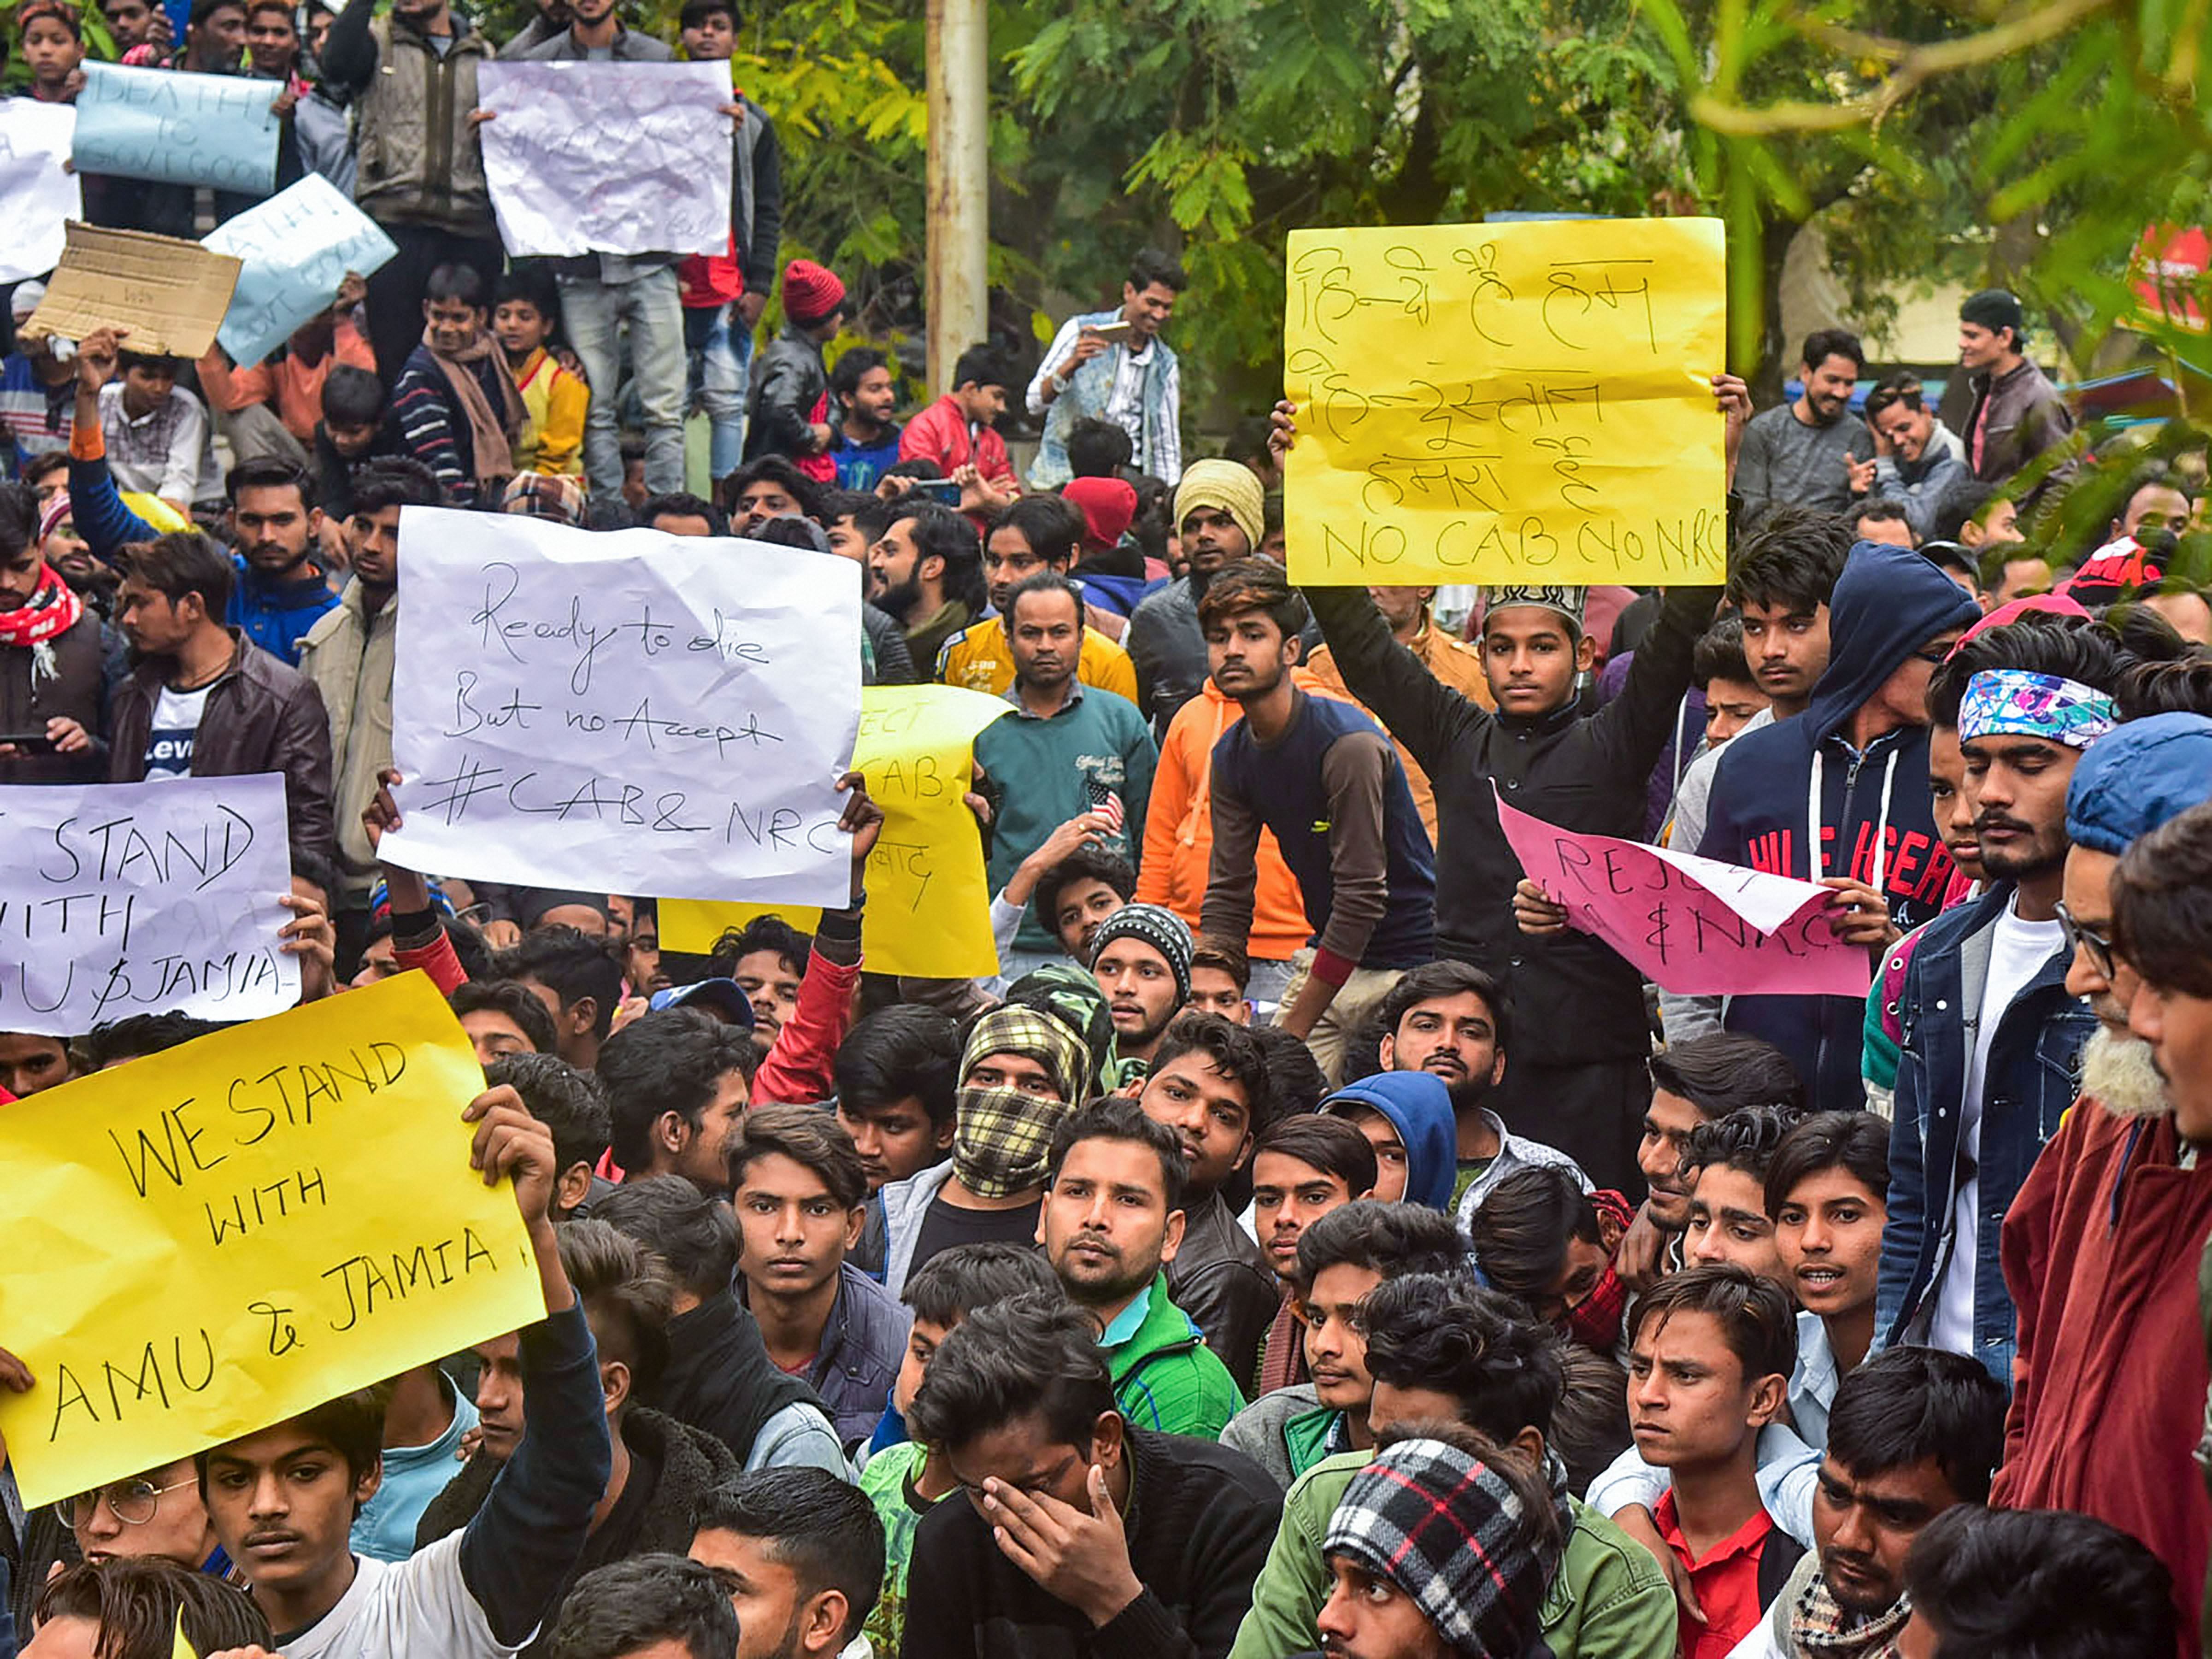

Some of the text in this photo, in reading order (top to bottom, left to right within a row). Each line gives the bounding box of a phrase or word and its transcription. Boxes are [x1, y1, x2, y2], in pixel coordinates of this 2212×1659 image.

[1542, 259, 1657, 354] हम
[1323, 520, 1406, 568] NO
[1435, 516, 1559, 566] CAB
[1656, 508, 1724, 572] NRC
[471, 562, 770, 695] Ready to die
[443, 670, 542, 737] But
[566, 706, 606, 733] no
[40, 804, 254, 891] STAND
[726, 801, 839, 854] NRC
[109, 1042, 406, 1197] WE STAND
[205, 1167, 327, 1245] WITH
[50, 1329, 214, 1442] AMU
[247, 1301, 305, 1355] &
